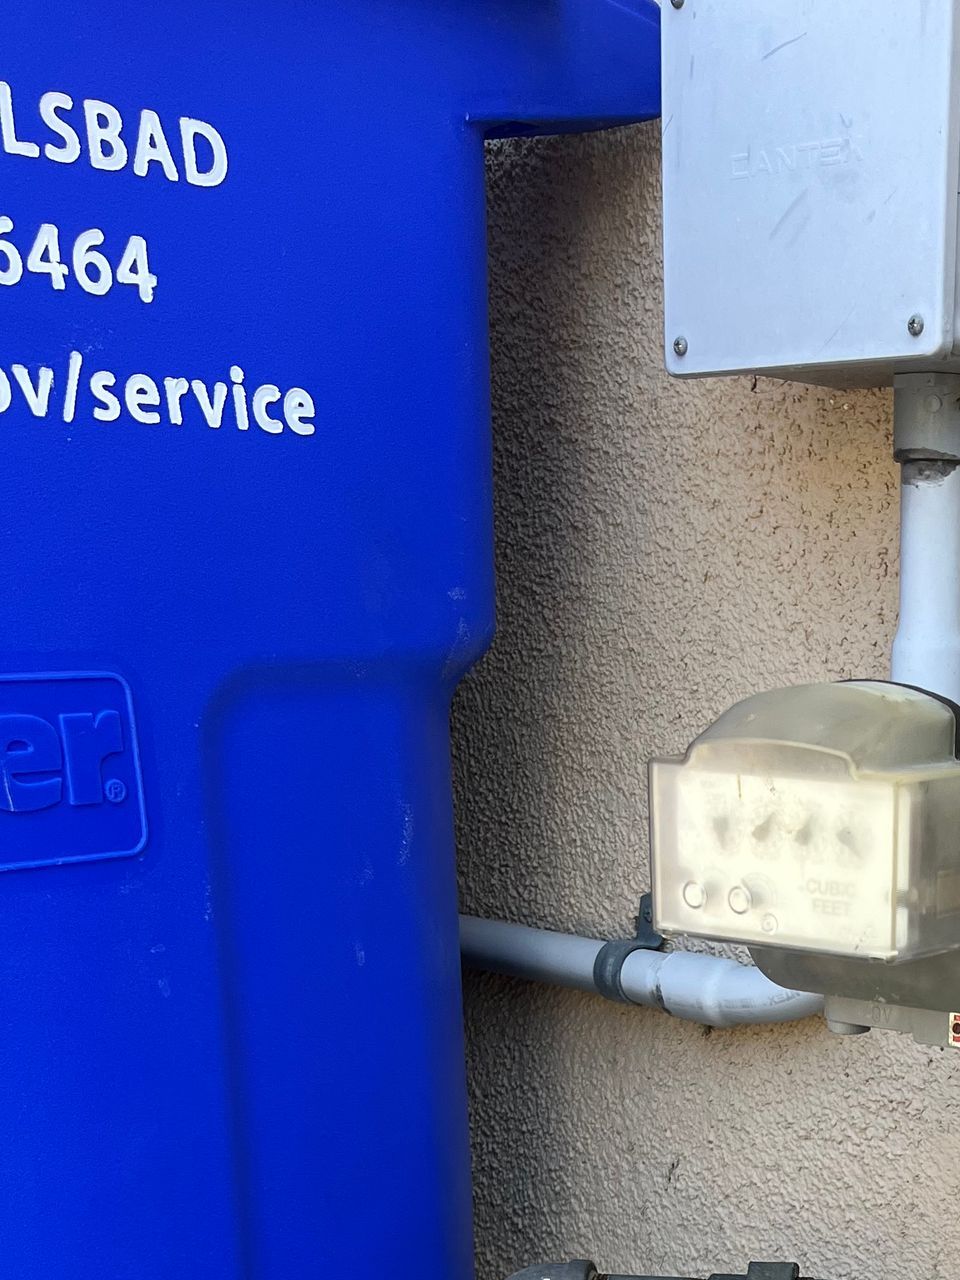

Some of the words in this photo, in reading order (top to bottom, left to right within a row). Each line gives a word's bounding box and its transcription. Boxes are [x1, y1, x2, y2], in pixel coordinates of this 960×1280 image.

[0, 81, 229, 187] LSBAD
[0, 215, 158, 303] 6464
[0, 350, 316, 436] v/service
[804, 877, 856, 897] CUBIC
[811, 899, 854, 917] FEET
